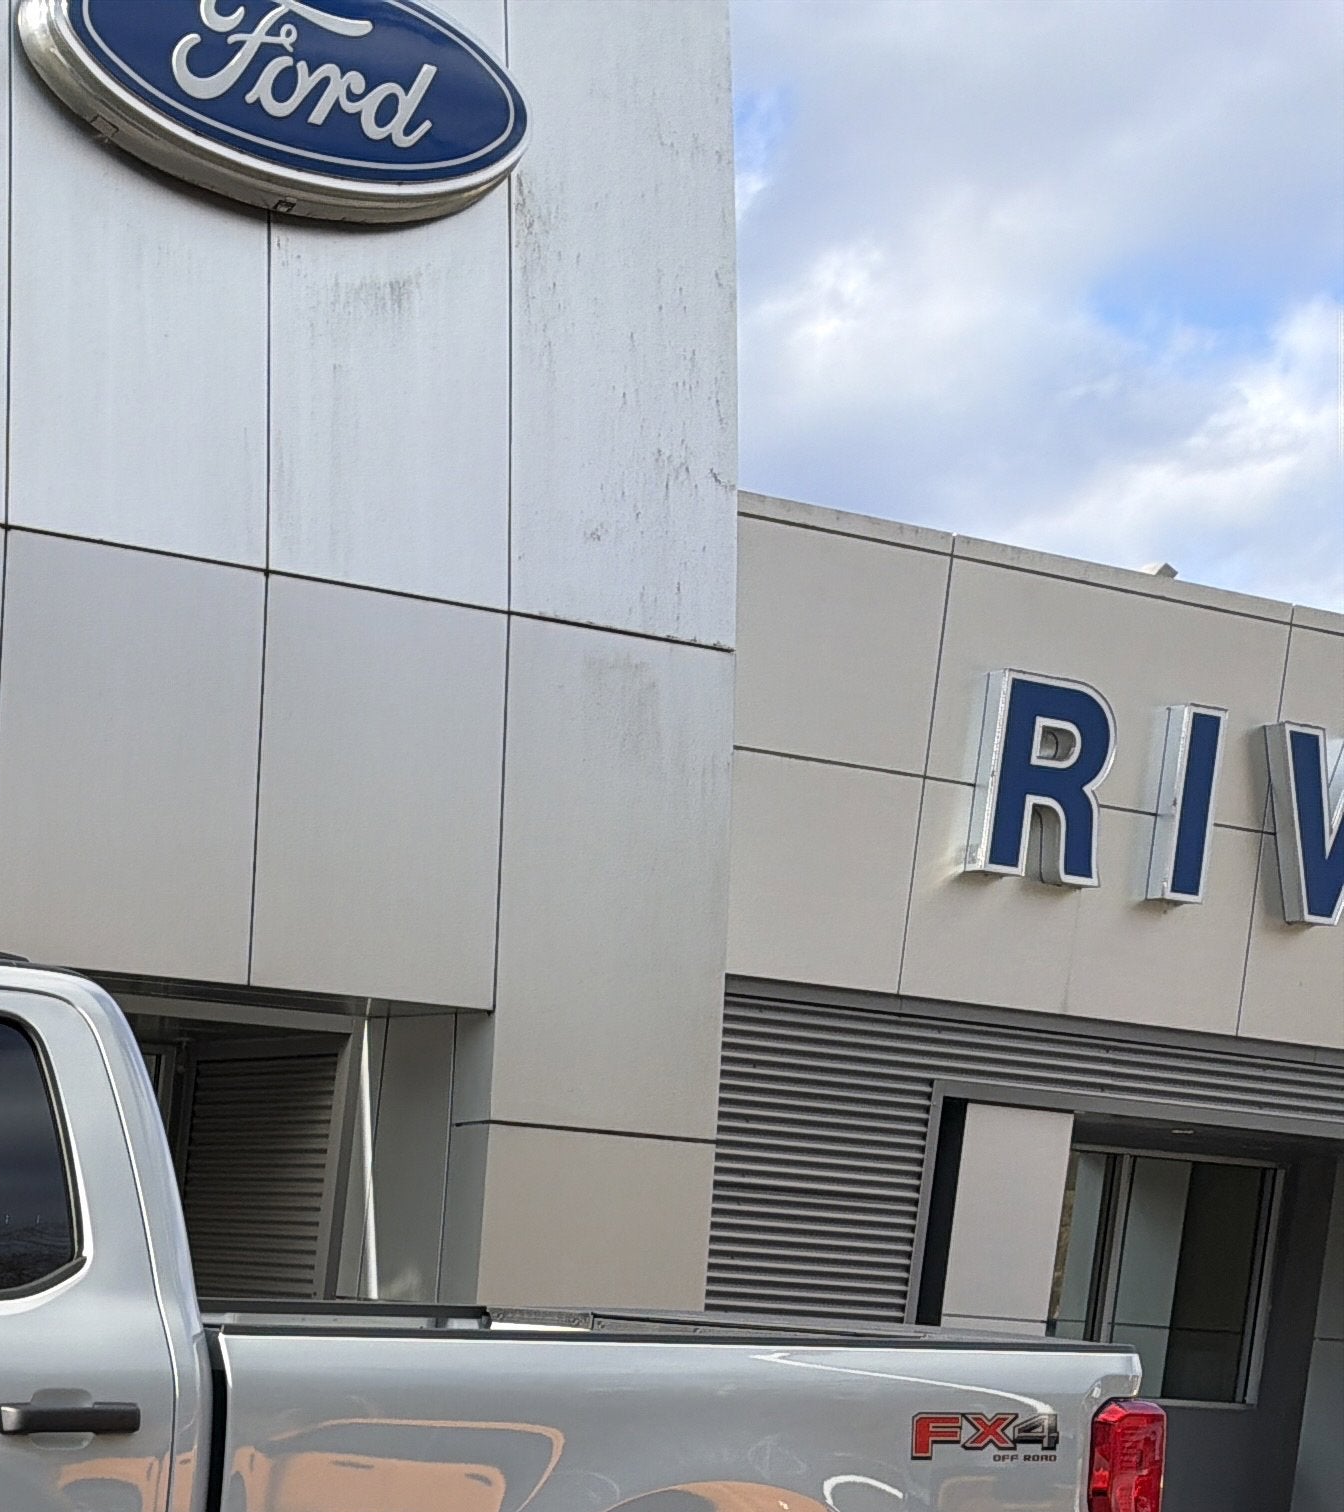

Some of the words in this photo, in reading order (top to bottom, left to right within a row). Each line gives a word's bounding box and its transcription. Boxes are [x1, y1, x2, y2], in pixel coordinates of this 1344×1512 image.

[172, 0, 437, 149] Ford
[911, 1412, 1059, 1460] FX4
[993, 1454, 1019, 1462] OFF
[1023, 1454, 1057, 1462] ROAD
